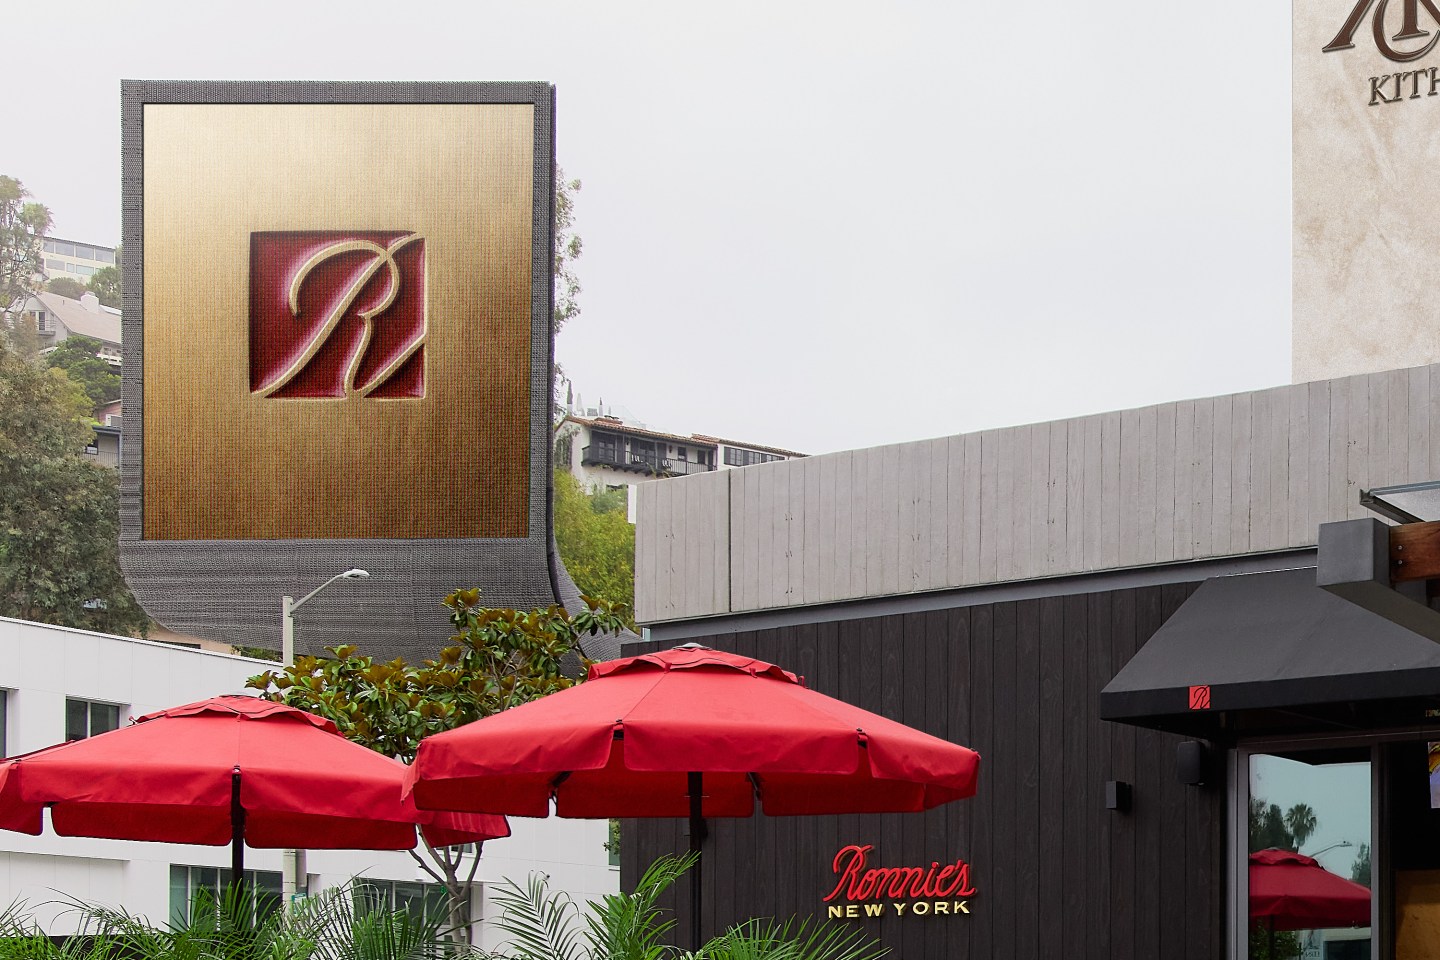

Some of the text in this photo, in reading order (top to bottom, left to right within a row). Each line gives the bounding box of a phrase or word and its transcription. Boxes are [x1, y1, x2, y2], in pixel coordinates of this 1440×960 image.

[250, 232, 427, 399] R
[822, 844, 977, 901] Ronnie's
[828, 900, 970, 919] NEW YORK
